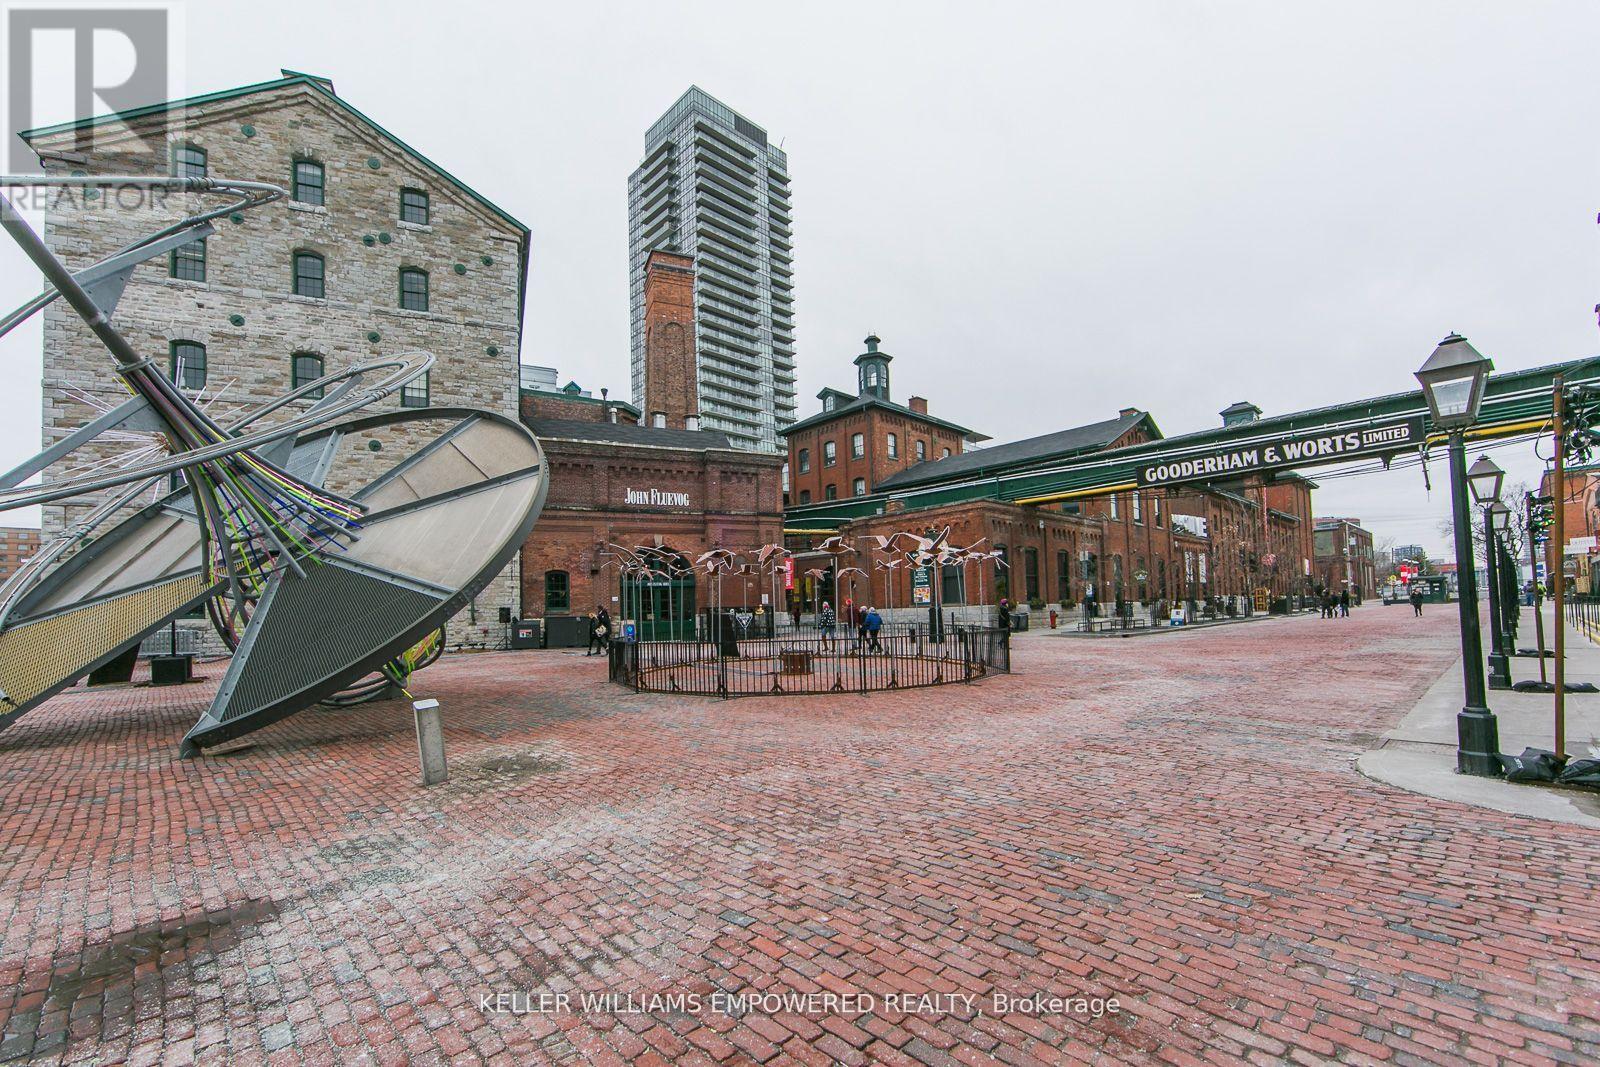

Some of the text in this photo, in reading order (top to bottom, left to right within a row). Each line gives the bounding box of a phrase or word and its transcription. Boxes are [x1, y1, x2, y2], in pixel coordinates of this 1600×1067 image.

[1145, 427, 1410, 483] GOODERHAM & WORTS LIMITED
